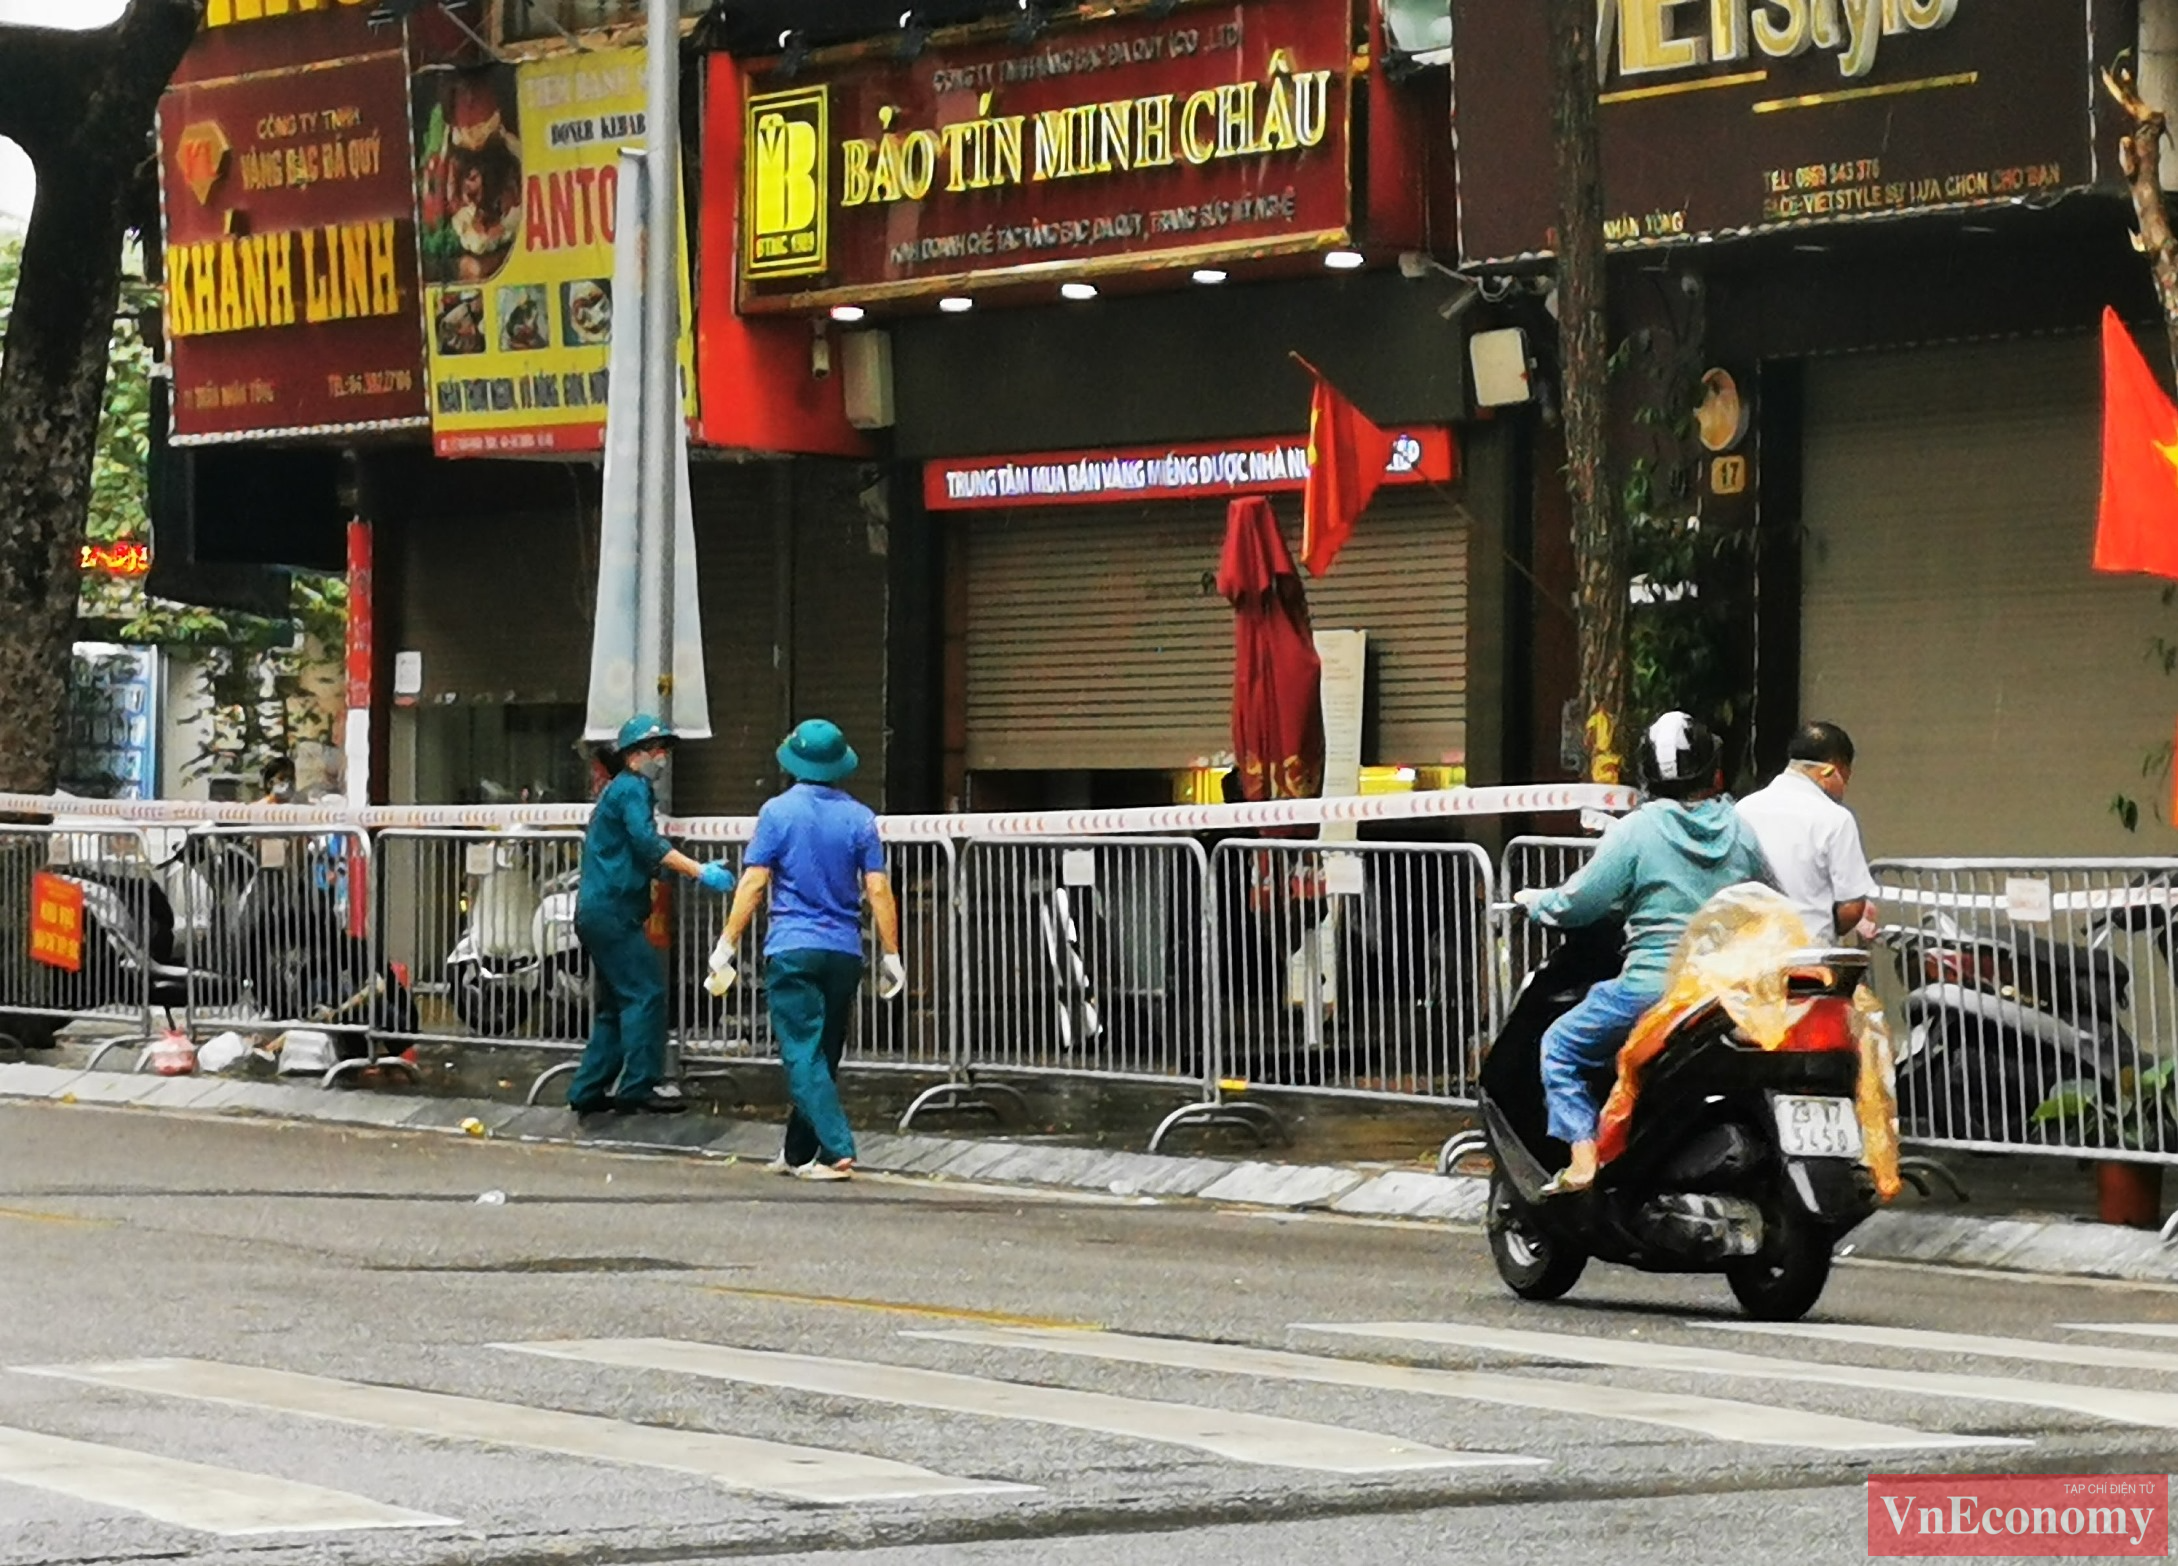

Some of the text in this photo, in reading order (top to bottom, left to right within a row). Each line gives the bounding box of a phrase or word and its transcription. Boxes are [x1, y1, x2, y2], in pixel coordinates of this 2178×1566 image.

[300, 111, 319, 133] TY
[841, 48, 1331, 207] BẢO TÍN MINH CHÂU
[167, 208, 399, 337] KHÁNH LINH
[946, 470, 998, 499] TRUNG
[999, 463, 1030, 496] TÂM
[1031, 464, 1067, 494] MUA
[1067, 456, 1101, 492] BÁN
[1101, 456, 1146, 490] VÀNG
[1147, 450, 1199, 487] MIẾNG
[1200, 450, 1249, 489] ĐƯỢC
[1250, 444, 1287, 481] NHÀ
[1721, 461, 1740, 486] 17
